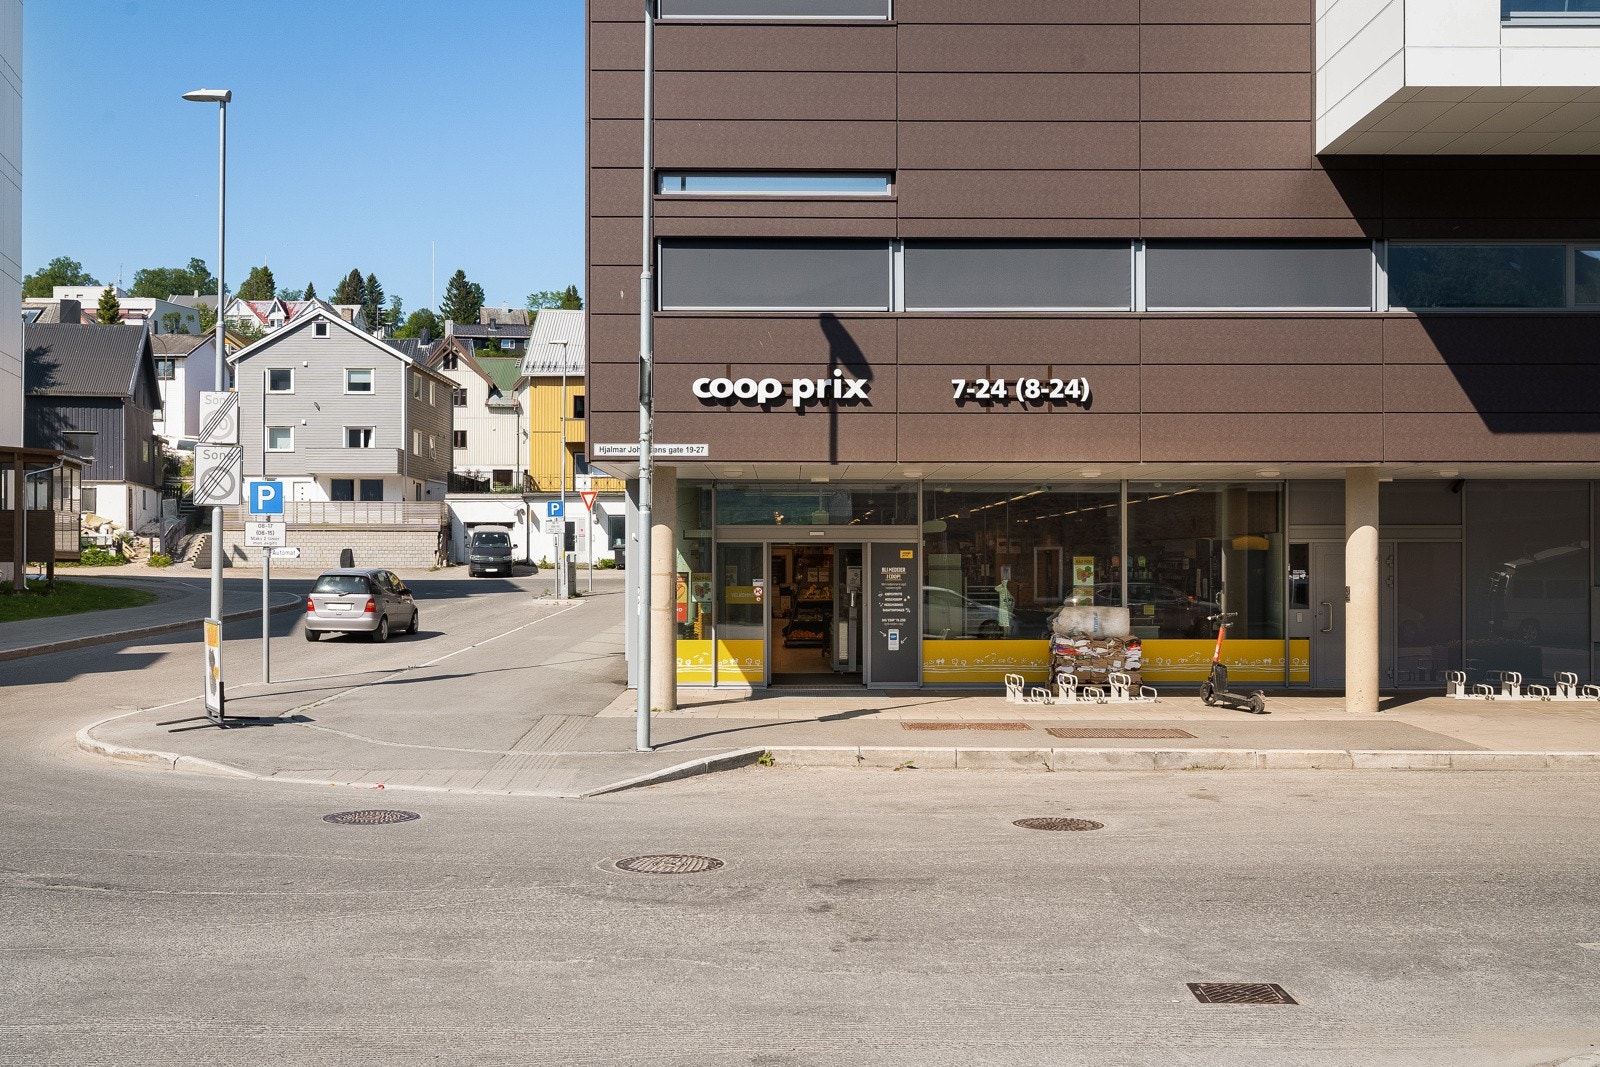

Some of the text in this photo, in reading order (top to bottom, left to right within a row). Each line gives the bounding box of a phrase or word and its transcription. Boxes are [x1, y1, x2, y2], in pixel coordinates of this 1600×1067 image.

[692, 369, 868, 407] coop prix
[951, 377, 1091, 402] 7-24 (8-24)
[205, 394, 230, 404] Son
[599, 445, 705, 454] Hjalmar Johens gate 19-27
